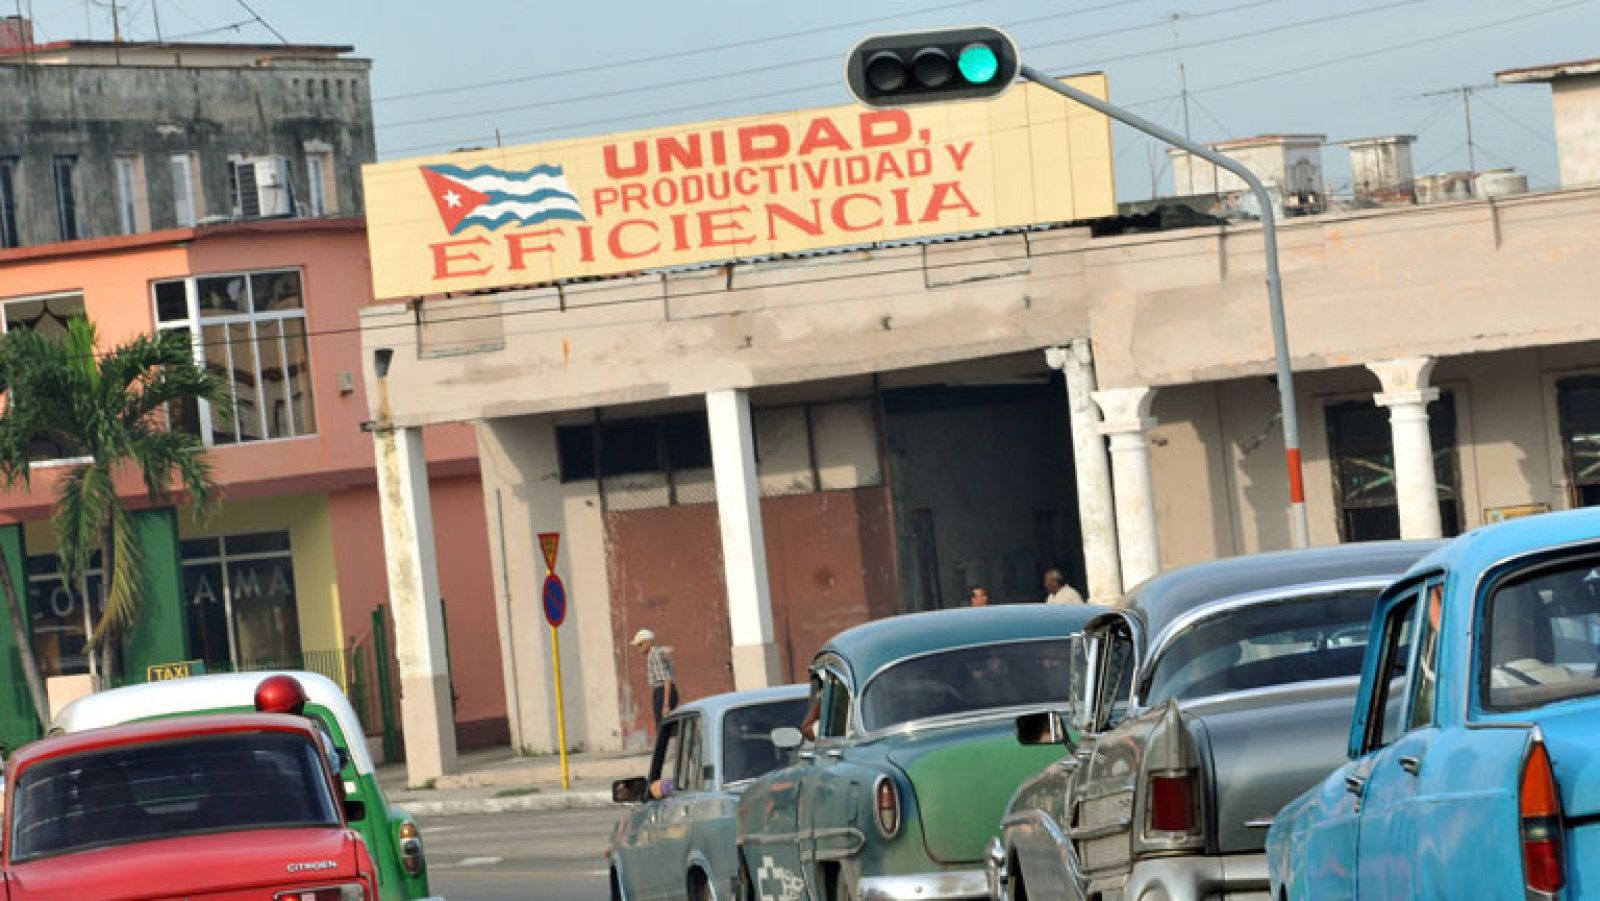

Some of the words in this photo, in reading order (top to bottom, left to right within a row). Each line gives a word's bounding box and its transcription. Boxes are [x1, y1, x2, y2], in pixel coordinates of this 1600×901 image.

[592, 147, 933, 218] PRODUCTIVIDAD
[945, 141, 974, 172] Y
[602, 108, 932, 181] UNIDAD,
[428, 180, 981, 281] EFICIENCIA
[154, 663, 189, 681] TAXI
